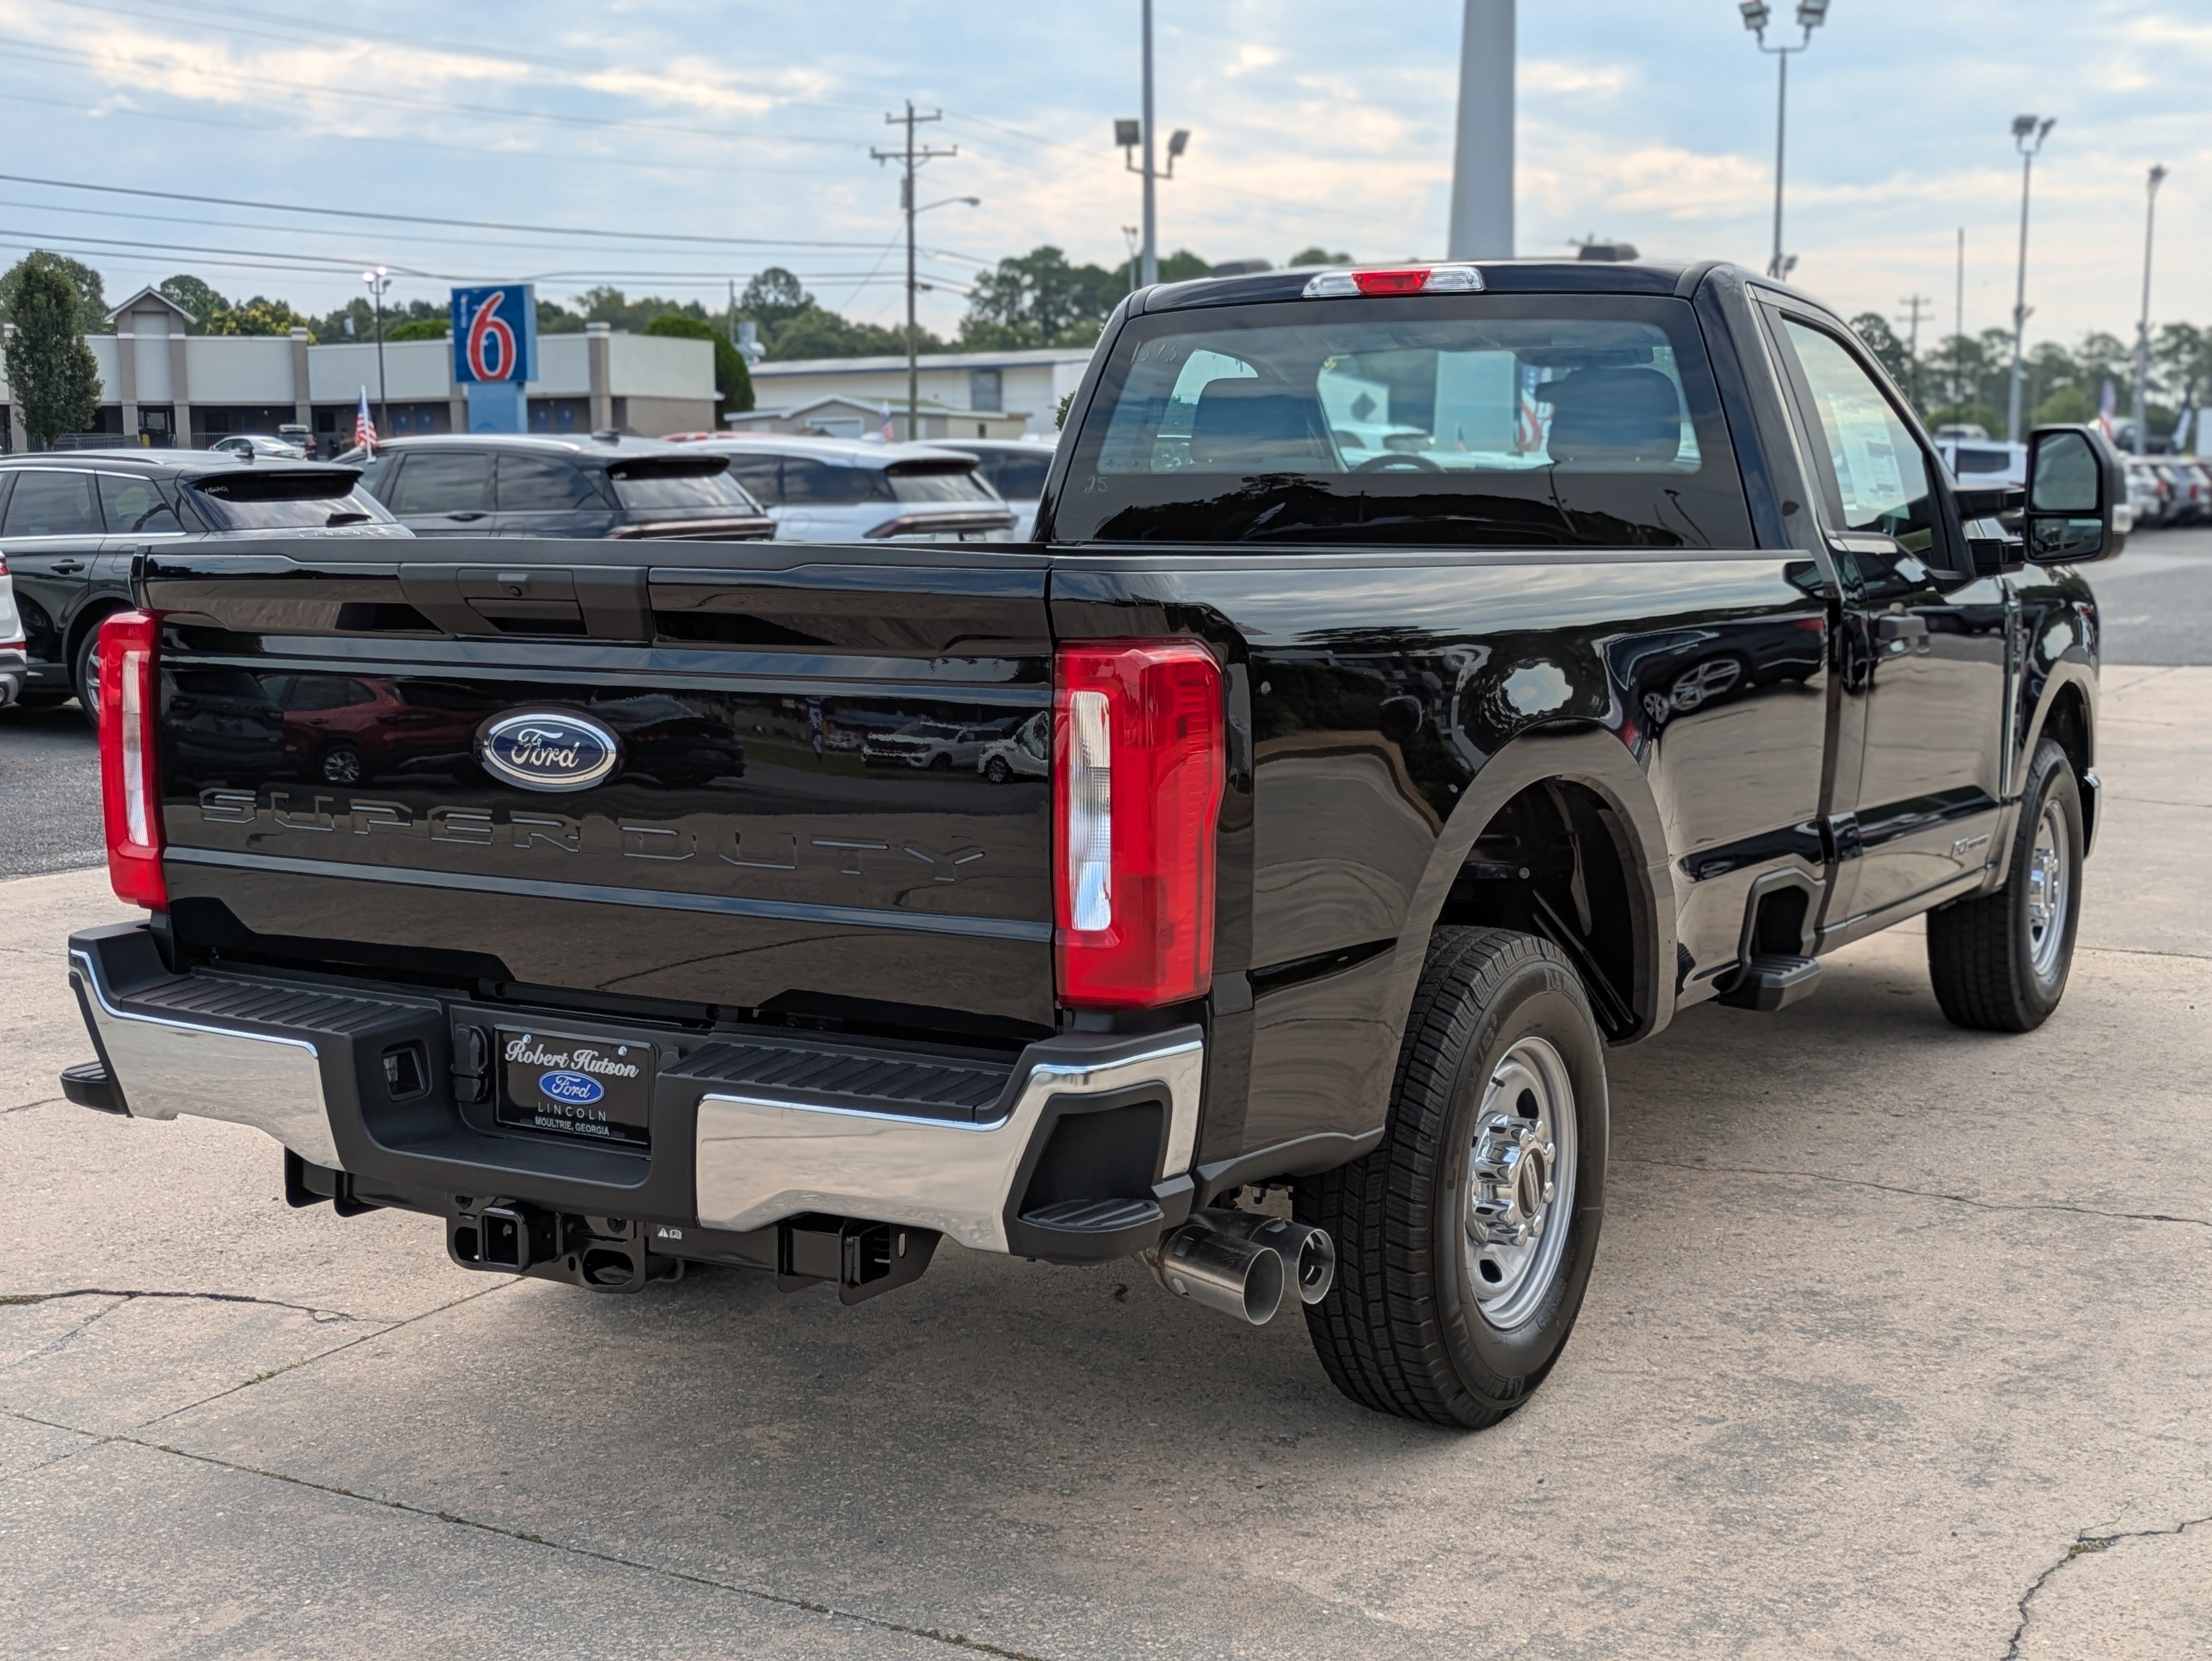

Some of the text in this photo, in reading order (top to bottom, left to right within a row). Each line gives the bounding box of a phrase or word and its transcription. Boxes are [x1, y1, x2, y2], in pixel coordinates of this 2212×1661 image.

[466, 291, 517, 381] 6
[299, 530, 390, 538] LINCOLN
[511, 728, 581, 768] Ford
[199, 788, 986, 882] SUPER DUTY
[505, 1040, 640, 1078] Robert Hutson
[551, 1075, 591, 1098] Ford
[535, 1116, 610, 1137] MOULTRIE, GEORGIA
[538, 1102, 607, 1122] LINCOLN
